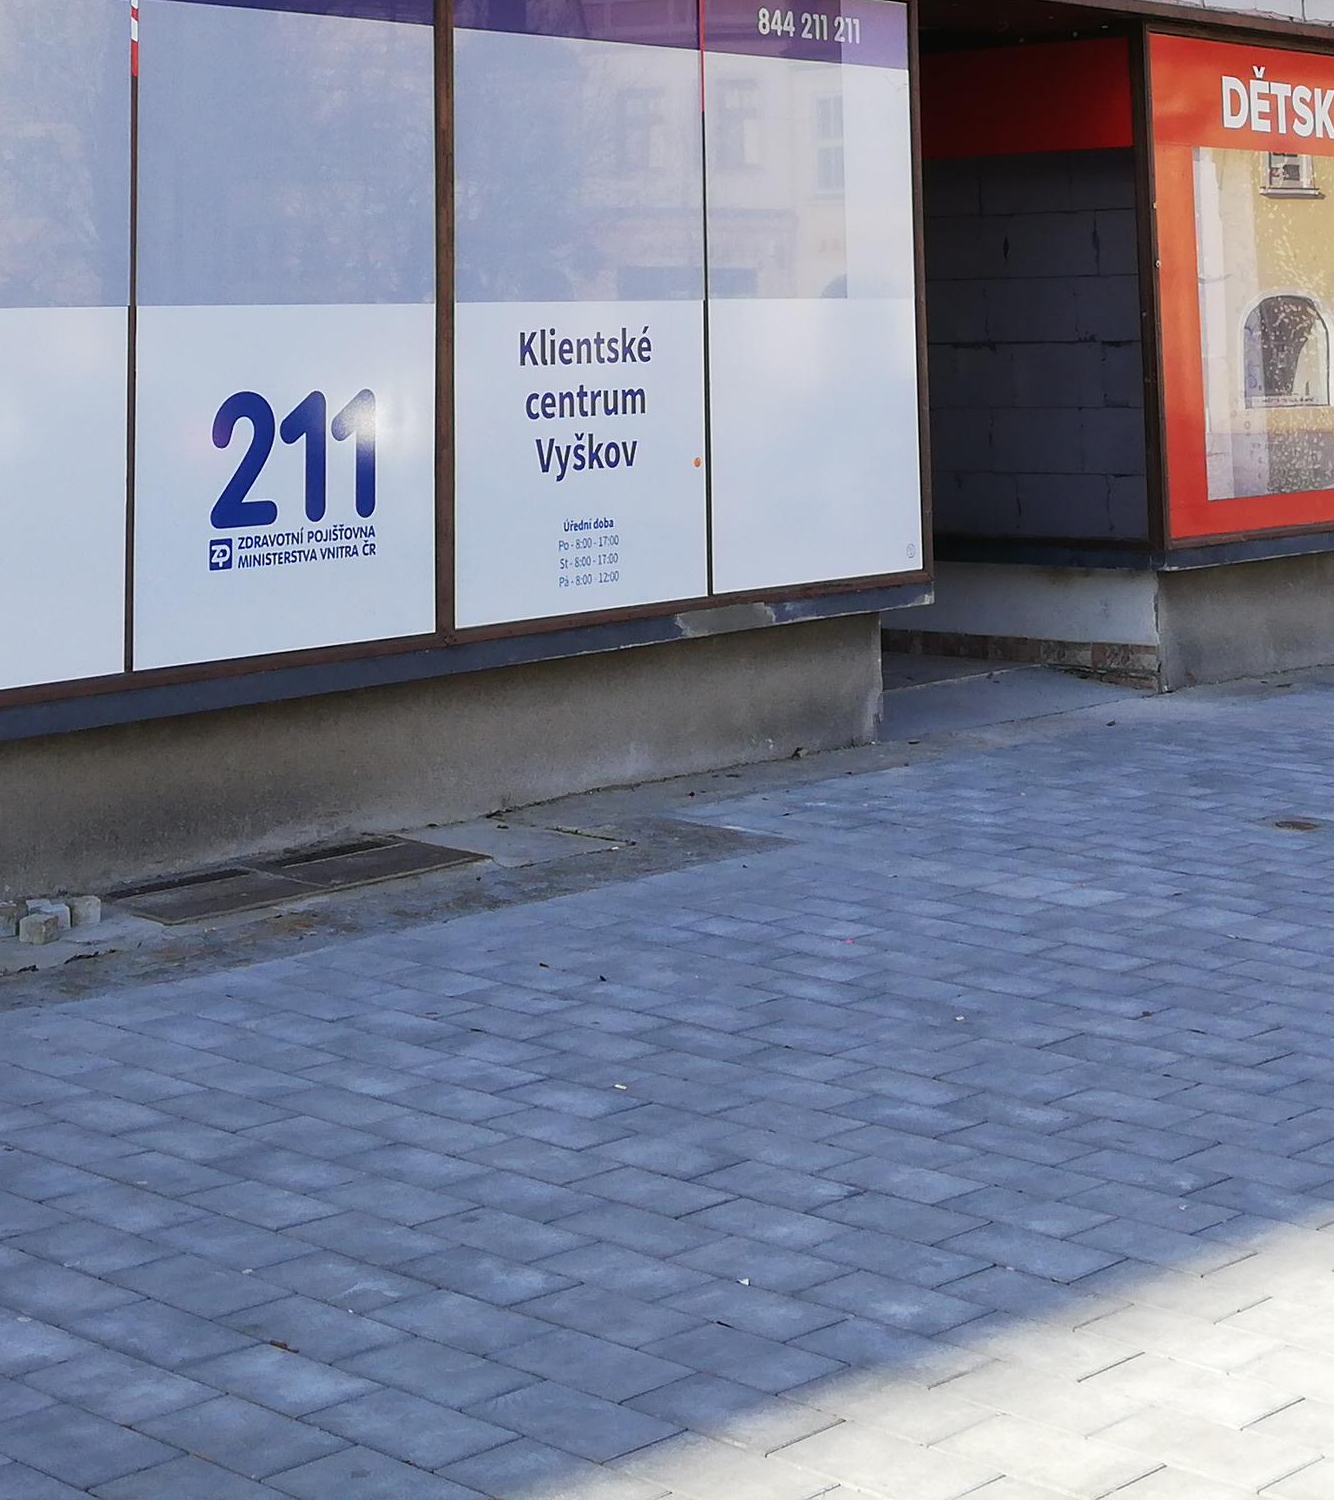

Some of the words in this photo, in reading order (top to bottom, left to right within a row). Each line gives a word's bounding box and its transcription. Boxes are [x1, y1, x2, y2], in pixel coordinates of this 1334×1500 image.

[758, 7, 795, 37] 844
[801, 12, 828, 41] 211
[834, 16, 860, 44] 211
[519, 326, 652, 367] Klientské
[525, 383, 647, 421] centrum
[209, 388, 376, 530] 211
[536, 433, 637, 482] Vyškov
[238, 527, 304, 550] ZDRAVOTNÍ
[307, 524, 376, 544] POJIŠŤOVNA
[593, 517, 614, 529] doba
[238, 548, 318, 569] MINISTERSTVA
[319, 544, 359, 561] VNITRA
[362, 540, 376, 556] ČR
